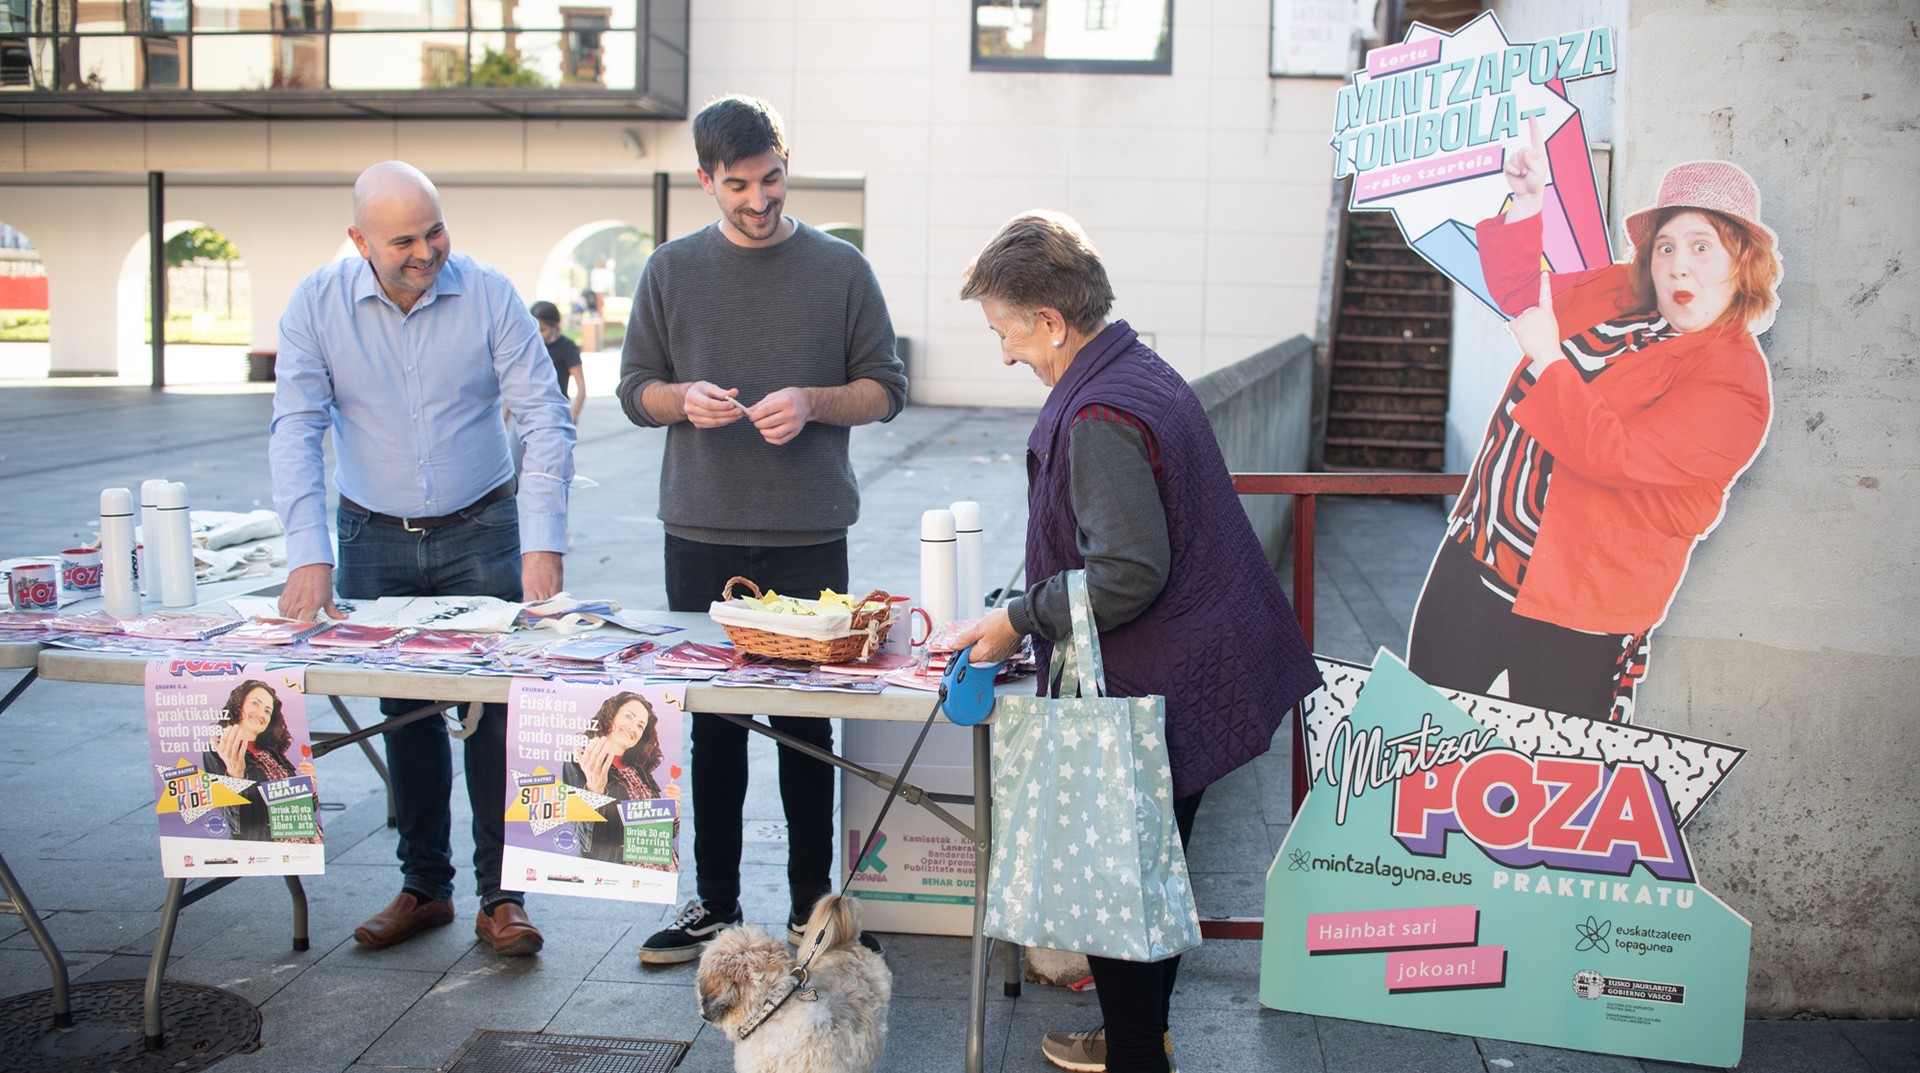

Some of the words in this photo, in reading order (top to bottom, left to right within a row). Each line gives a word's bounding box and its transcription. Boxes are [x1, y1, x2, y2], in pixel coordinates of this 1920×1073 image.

[1379, 47, 1428, 69] Lortu
[1335, 27, 1613, 132] MINTZAPOZA
[1364, 171, 1412, 191] -rako
[1418, 154, 1494, 181] txartela
[63, 566, 101, 586] POZ
[155, 692, 208, 706] Euskara
[519, 693, 577, 713] Euskara
[157, 708, 231, 725] praktikatuz
[518, 713, 599, 732] praktikatuz
[158, 724, 189, 738] ondo
[518, 729, 552, 744] ondo
[160, 740, 189, 754] tzen
[518, 745, 549, 761] tzen
[1326, 713, 1498, 826] Mintza
[267, 780, 290, 791] IZEN
[268, 784, 309, 800] EMATEA
[178, 790, 213, 811] KIDE!
[627, 801, 651, 811] IZEN
[1392, 746, 1680, 866] POZA
[271, 806, 290, 815] Urriak
[290, 805, 299, 814] 30
[300, 805, 311, 813] eta
[271, 812, 312, 822] urtarrilak
[529, 801, 566, 820] KIDE!
[627, 807, 671, 820] EMATEA
[272, 821, 293, 830] 30era
[298, 821, 314, 830] arte
[627, 828, 647, 837] Urriak
[648, 829, 657, 838] 30
[659, 830, 670, 839] eta
[903, 834, 951, 844] Kamisetak
[626, 837, 670, 848] urtarrilak
[626, 844, 648, 854] 30era
[654, 846, 670, 856] arte
[920, 857, 947, 866] Opari
[928, 850, 976, 859] Banderola
[904, 864, 954, 873] Publizitate
[1312, 854, 1472, 887] mintzalaguna.eus
[922, 878, 953, 887] BEHAR
[1493, 871, 1694, 910] PRAKTIKATU
[1319, 921, 1395, 941] Hainbat
[1402, 918, 1437, 937] sari
[1616, 925, 1692, 942] euskaltzaleen
[1615, 939, 1674, 956] topagunea
[1397, 959, 1477, 983] jokoan!
[1607, 988, 1646, 998] GOBIERNO
[1647, 993, 1672, 1001] VASCO
[1608, 980, 1631, 989] EUSKO
[1632, 982, 1677, 994] JAURLARITZA
